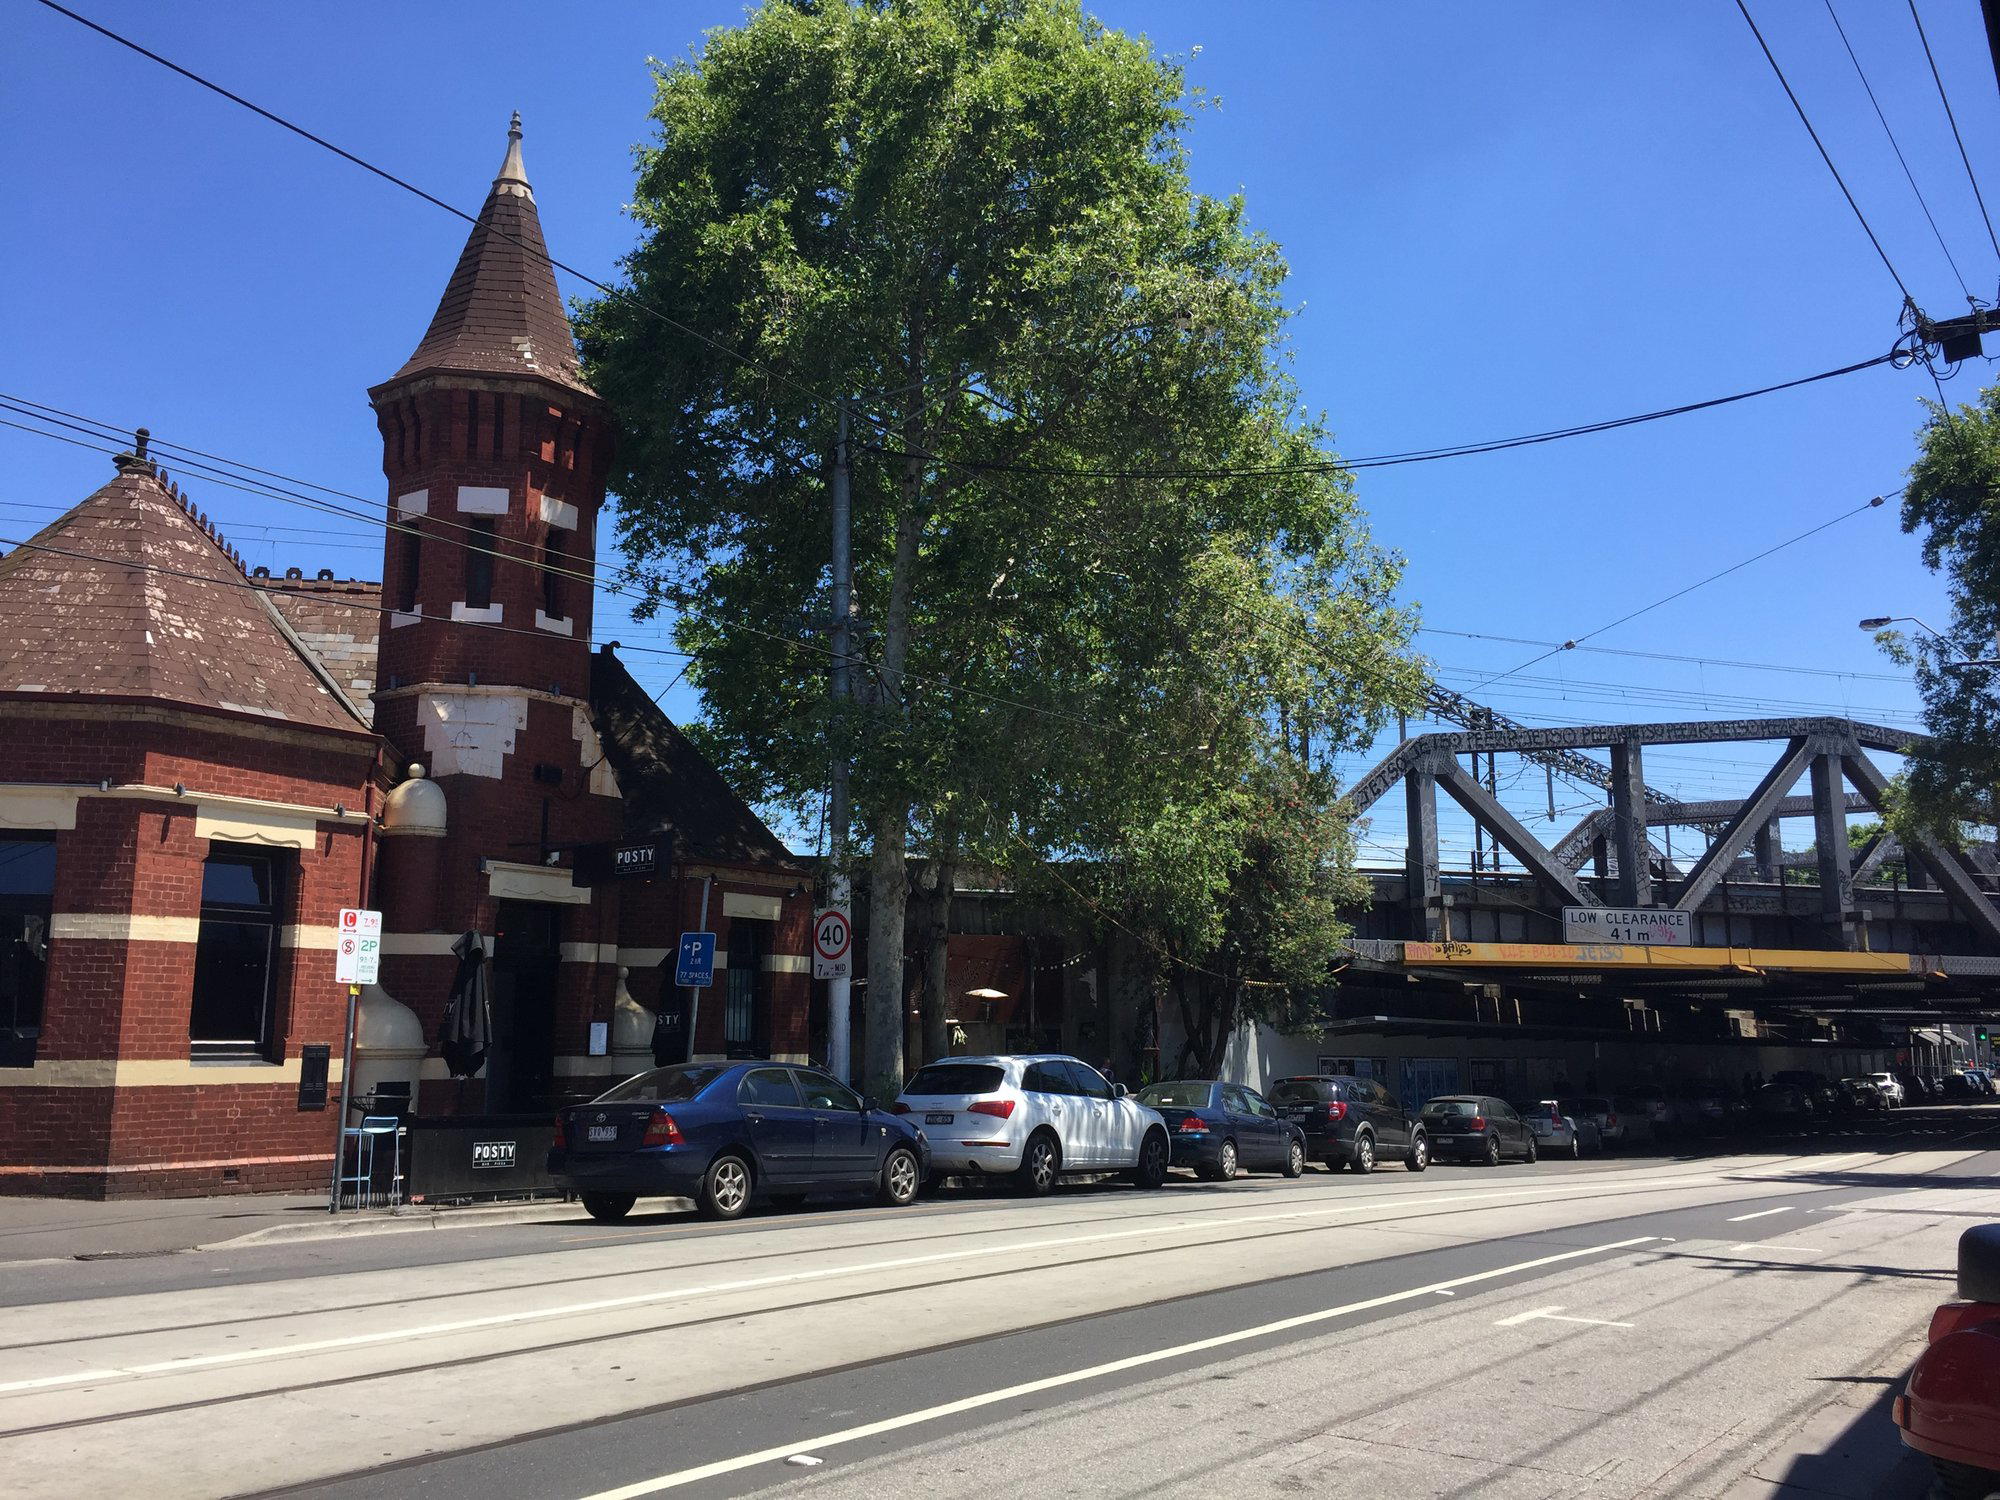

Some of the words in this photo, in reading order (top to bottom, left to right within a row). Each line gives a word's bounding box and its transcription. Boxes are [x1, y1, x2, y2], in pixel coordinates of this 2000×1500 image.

[617, 848, 654, 864] POSTY
[1570, 912, 1597, 924] LOW
[1605, 913, 1684, 926] CLEARANCE
[820, 924, 844, 946] 40
[1637, 932, 1650, 941] m
[361, 940, 378, 952] 2P
[691, 941, 702, 957] P
[688, 971, 709, 979] SPACES
[475, 1145, 515, 1159] POSTY
